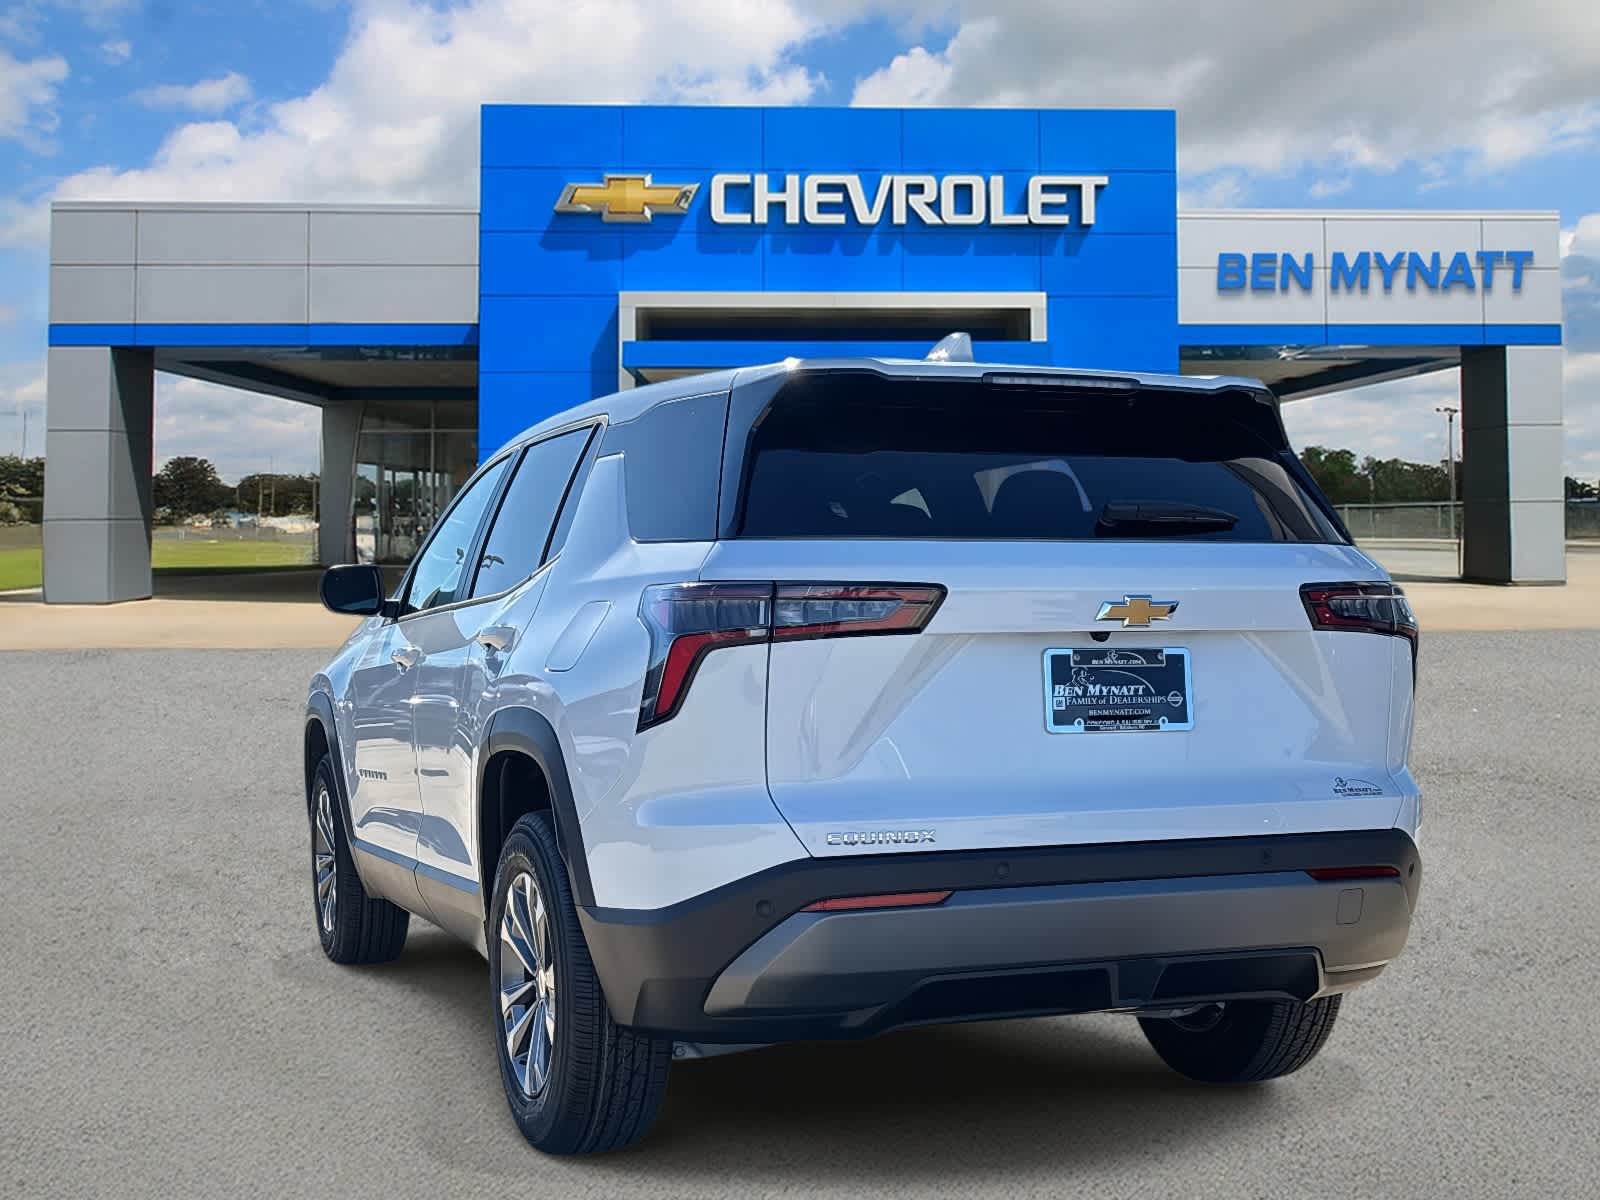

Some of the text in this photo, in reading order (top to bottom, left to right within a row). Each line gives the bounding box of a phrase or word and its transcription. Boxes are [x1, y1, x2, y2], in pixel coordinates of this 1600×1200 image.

[710, 174, 1109, 226] CHEVROLET
[1217, 251, 1534, 290] BEN MYNATT
[1053, 684, 1146, 697] BEN MYNATT
[1066, 697, 1098, 706] FAMILY
[1098, 697, 1107, 705] of
[1109, 696, 1167, 705] DEALERSHIPS
[1088, 708, 1152, 717] BENMYNATT.COM
[827, 829, 936, 846] EQUINOX
